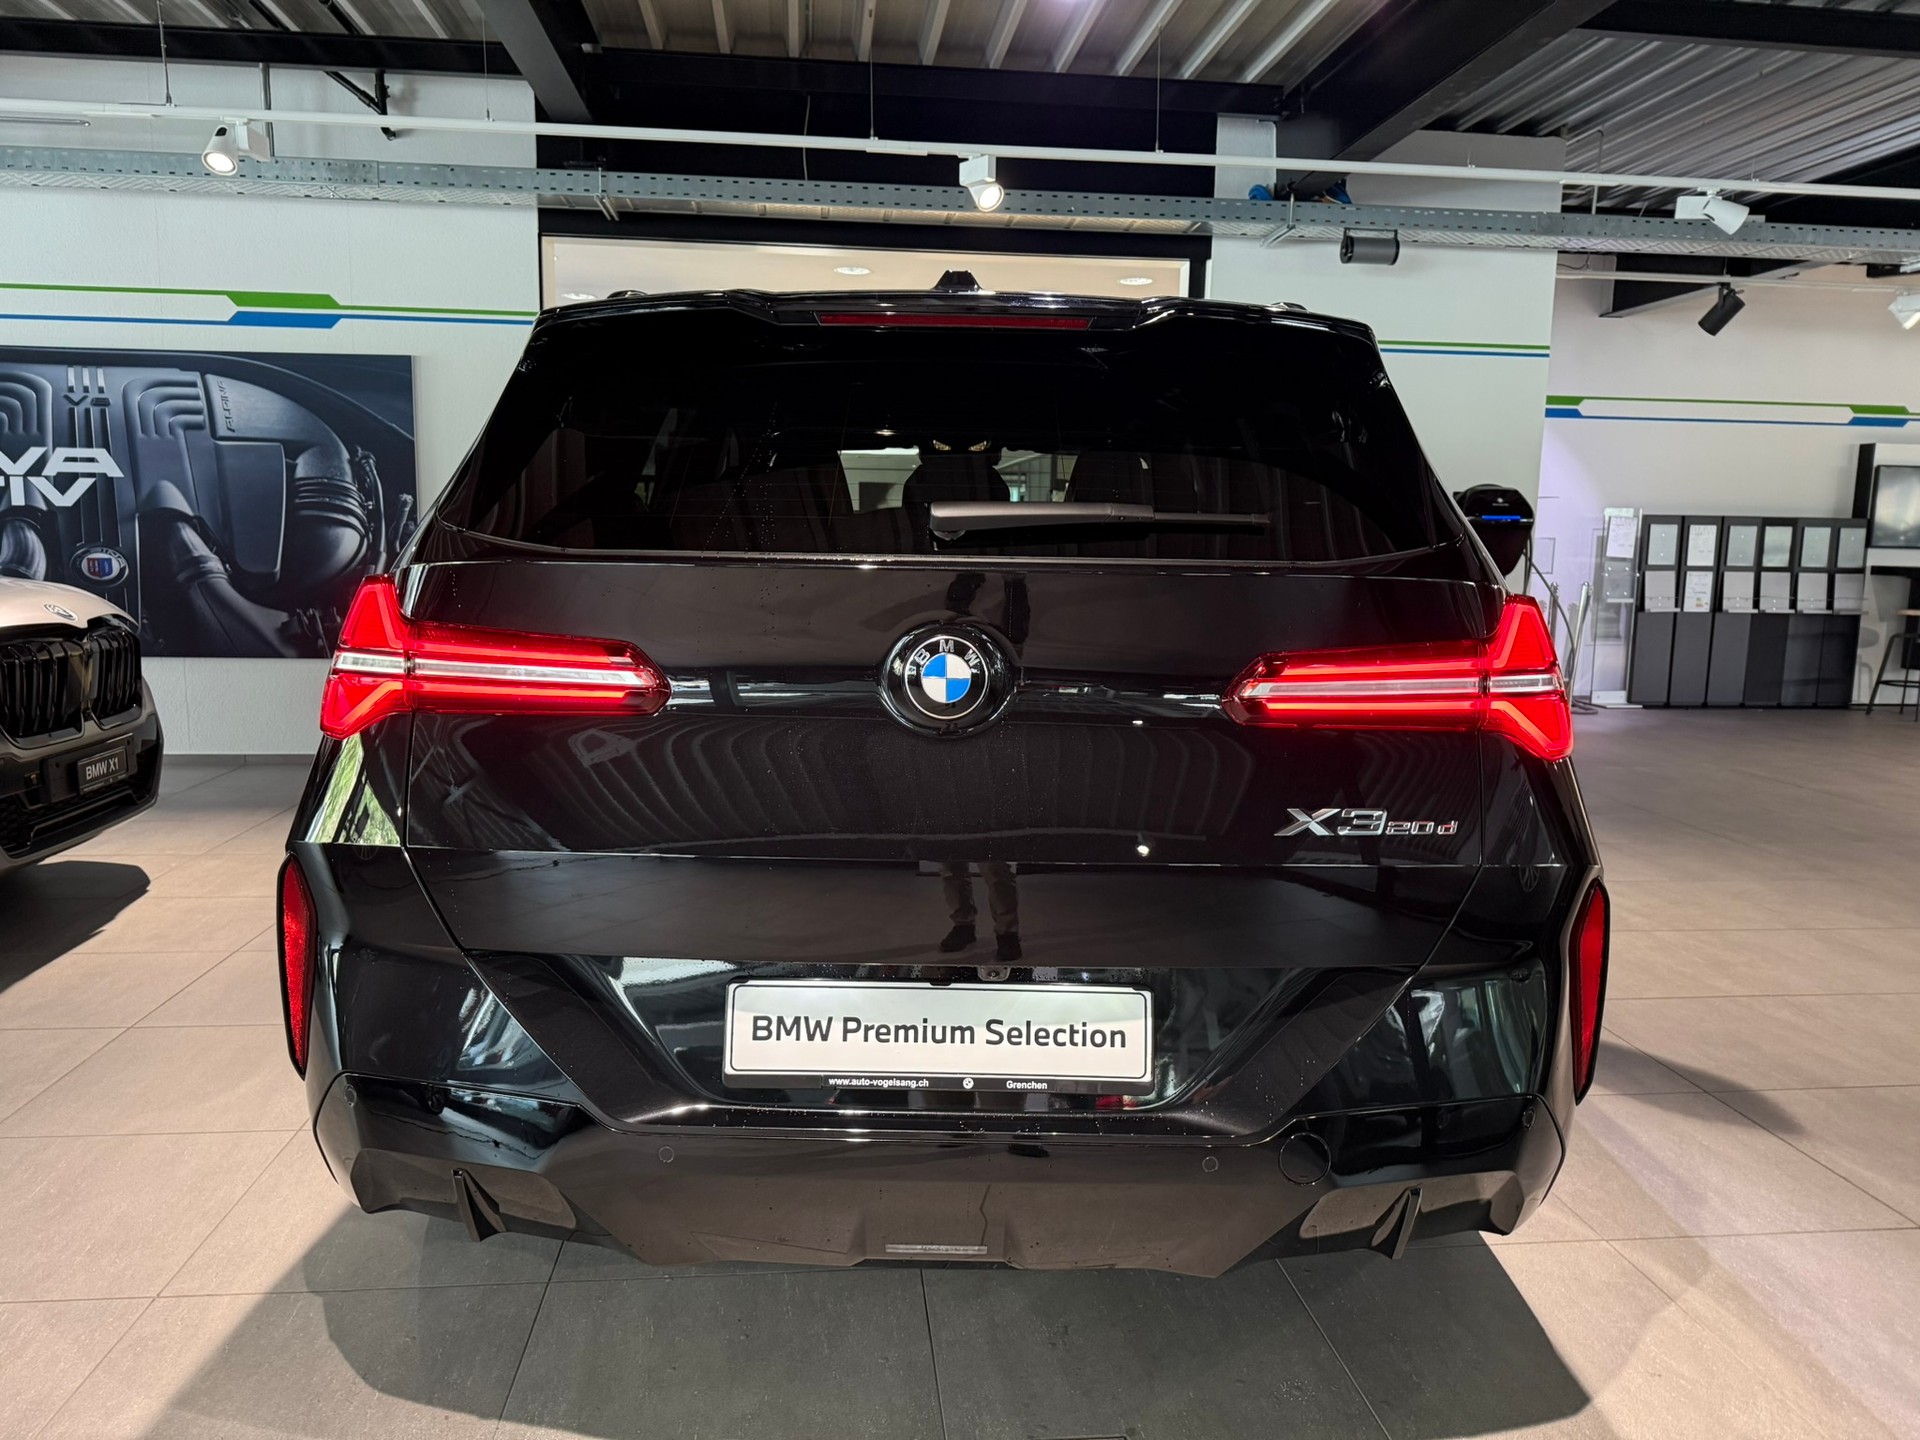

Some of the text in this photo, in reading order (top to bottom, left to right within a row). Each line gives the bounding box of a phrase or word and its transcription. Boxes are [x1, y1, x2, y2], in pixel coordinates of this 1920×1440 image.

[63, 394, 111, 407] V8
[0, 475, 97, 507] IV
[914, 639, 981, 668] BMW
[85, 756, 119, 780] BMW X1
[751, 1015, 1127, 1048] BMW Premium Selection
[828, 1077, 1048, 1090] www.auto-vogelsang.ch Grenchen
